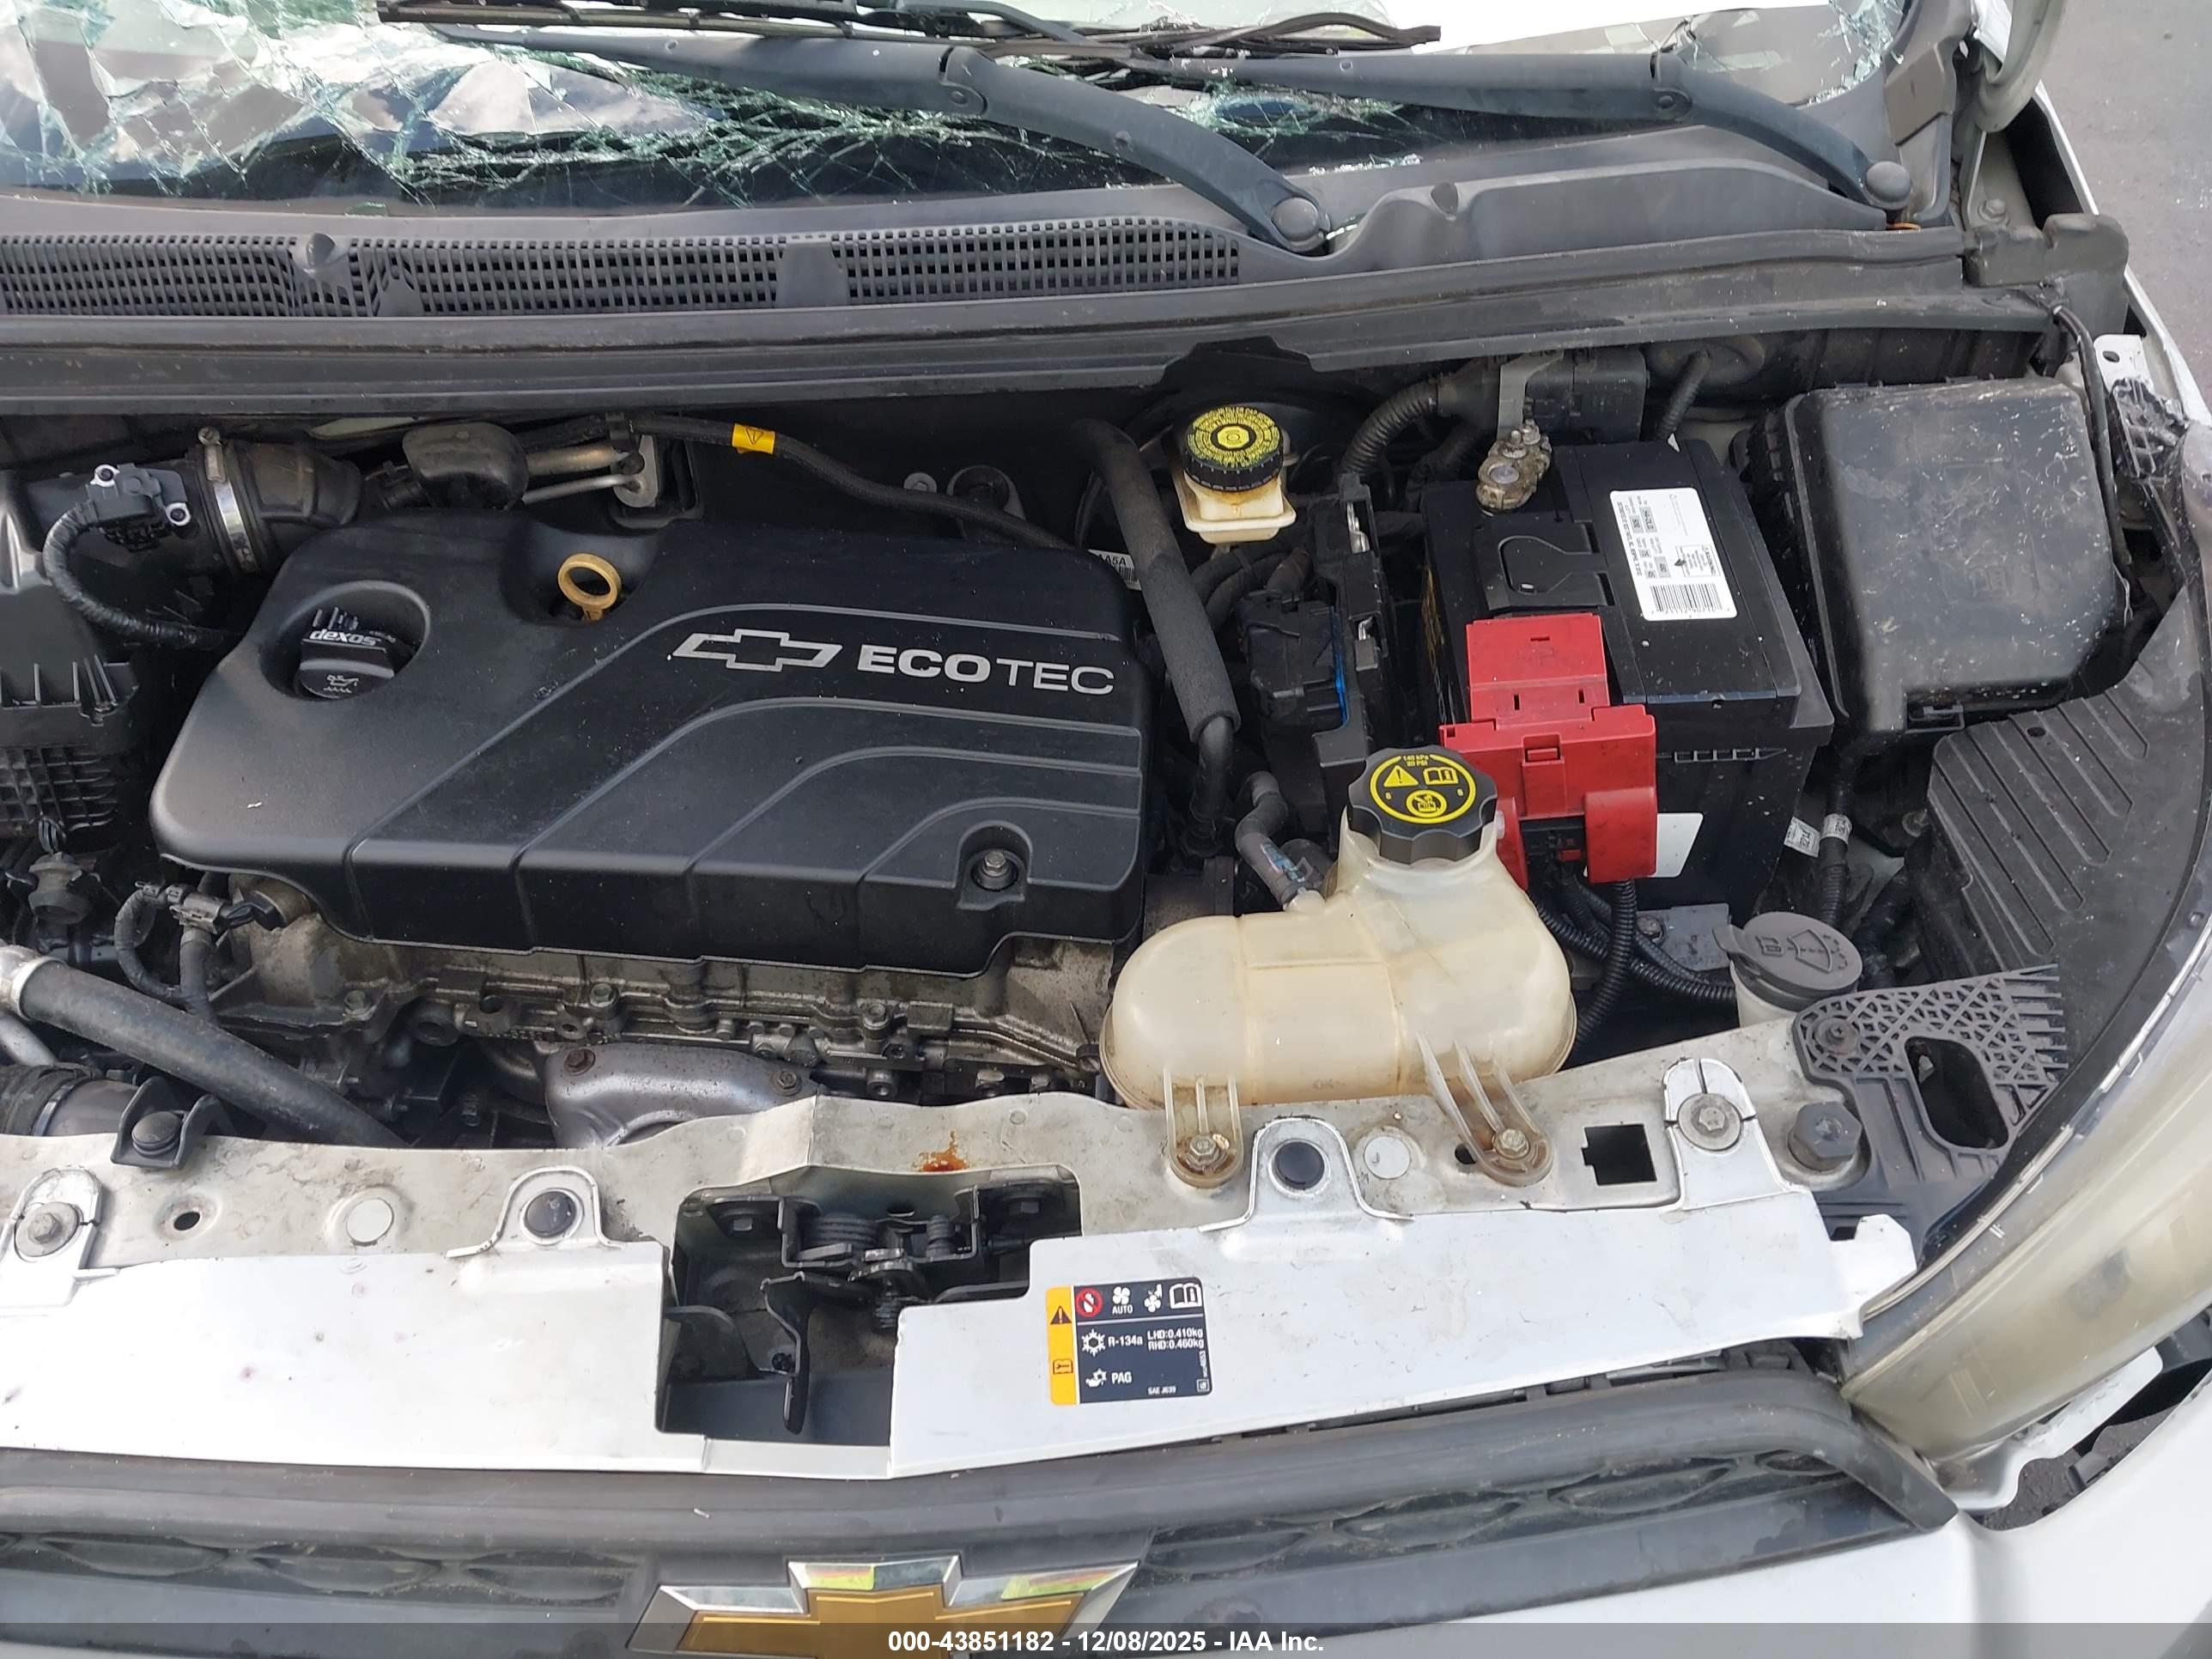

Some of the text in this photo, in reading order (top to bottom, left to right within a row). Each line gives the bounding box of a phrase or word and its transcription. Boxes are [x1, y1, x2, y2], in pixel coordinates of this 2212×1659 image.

[309, 629, 381, 646] dexos
[857, 644, 1115, 696] ECOTEC
[1112, 1304, 1133, 1316] AUTO
[1108, 1335, 1144, 1347] R-134a
[1111, 1371, 1133, 1384] PAG
